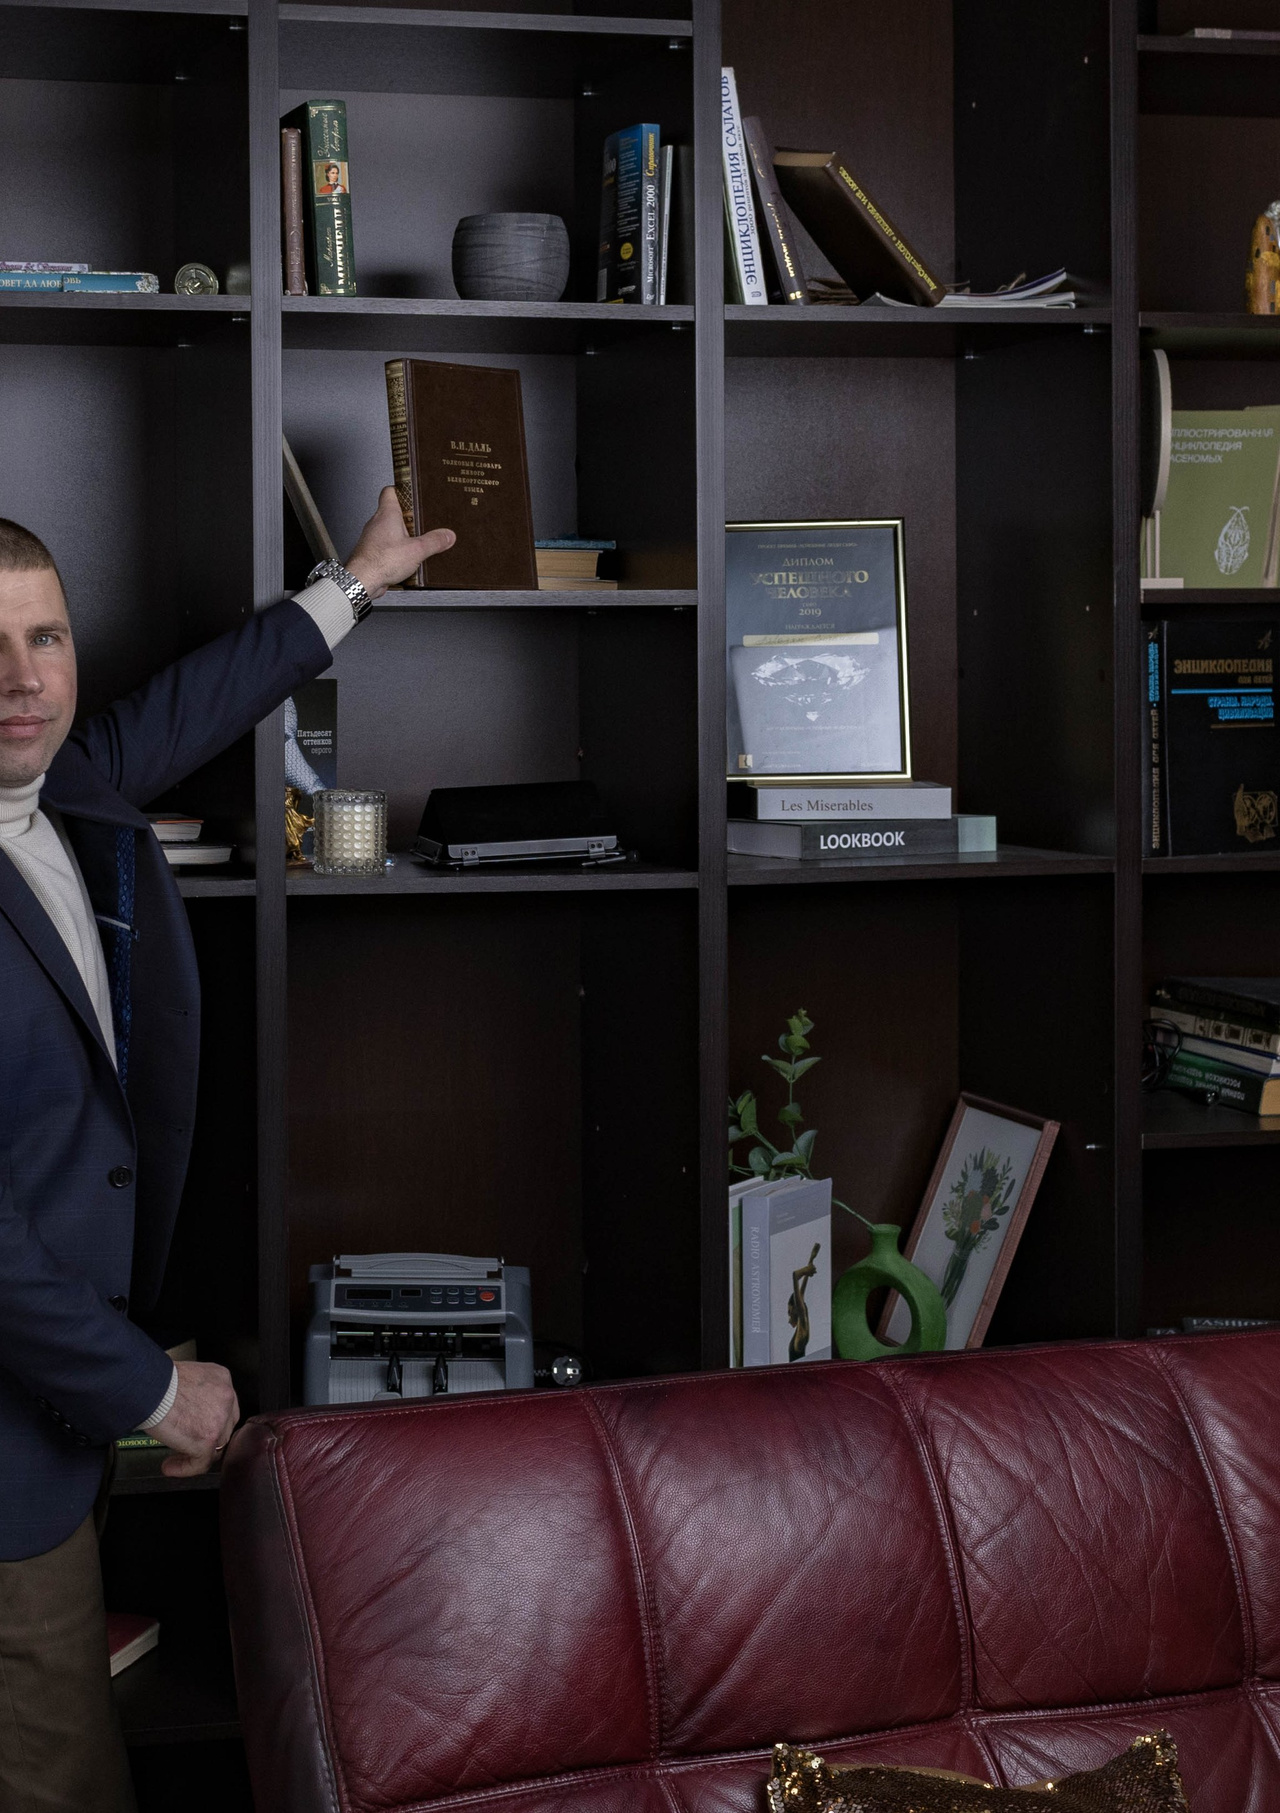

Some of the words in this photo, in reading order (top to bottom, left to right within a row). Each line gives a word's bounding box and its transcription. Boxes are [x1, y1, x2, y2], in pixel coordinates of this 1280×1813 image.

[721, 76, 737, 147] САЛАТОВ
[646, 184, 656, 208] 2000
[646, 208, 656, 240] EXCEL
[728, 152, 757, 284] ЭНЦИКЛОПЕДИЯ
[23, 279, 38, 289] ДА
[39, 277, 81, 289] ЛЮБОВЬ
[1171, 441, 1243, 452] НЦИКЛОПЕДИЯ
[442, 459, 474, 467] ТОЛКОВЫЙ
[475, 461, 502, 470] СЛОВАРЬ
[1170, 454, 1223, 463] АСЕКОМЫХ
[461, 469, 485, 477] ЖИВОГО
[464, 486, 484, 494] ЯЗЫКА
[782, 557, 834, 567] ДИПЛОМ
[752, 570, 870, 586] УСПЕШНОГО
[766, 587, 852, 599] ЧЕЛОВЕКА
[799, 608, 822, 617] 2019
[1174, 658, 1273, 674] ЭНЦИКЛОПЕДИЯ
[297, 730, 332, 738] Пятьдесят
[311, 747, 332, 755] серого
[781, 800, 803, 811] Les
[807, 799, 874, 812] Miserables
[820, 831, 905, 850] LOOKBOOK
[1204, 1072, 1241, 1088] РОССИЙСКОЙ
[750, 1226, 760, 1260] RADIO
[751, 1265, 761, 1334] ASTRONOMER
